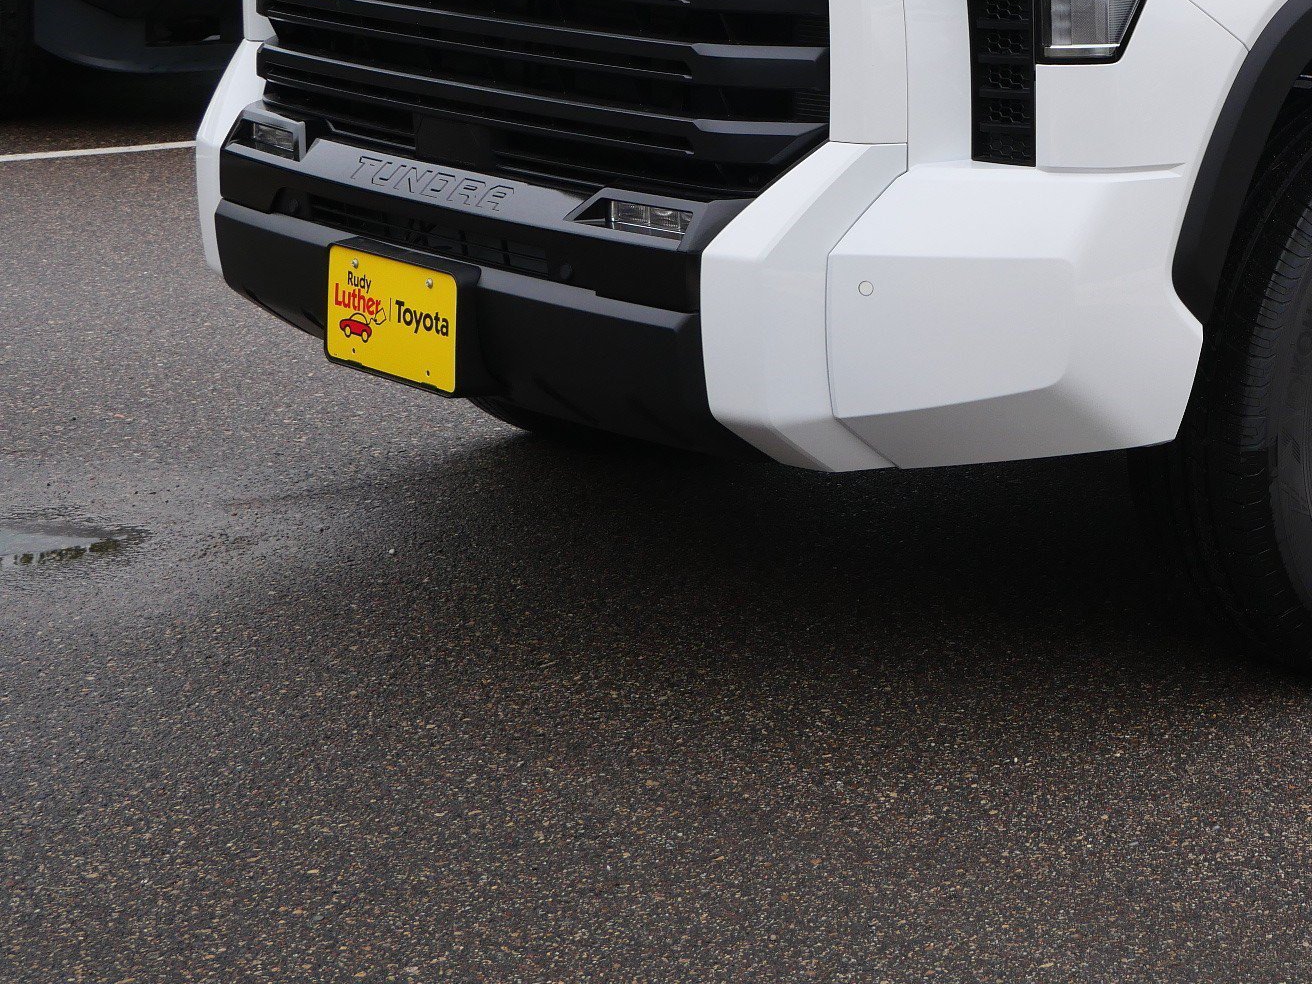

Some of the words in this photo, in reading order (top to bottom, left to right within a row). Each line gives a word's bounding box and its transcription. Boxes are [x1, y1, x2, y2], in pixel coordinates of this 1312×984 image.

[350, 155, 515, 212] TUNDRA
[334, 282, 382, 316] Luther
[347, 270, 372, 294] Rudy
[394, 299, 449, 337] Toyota
